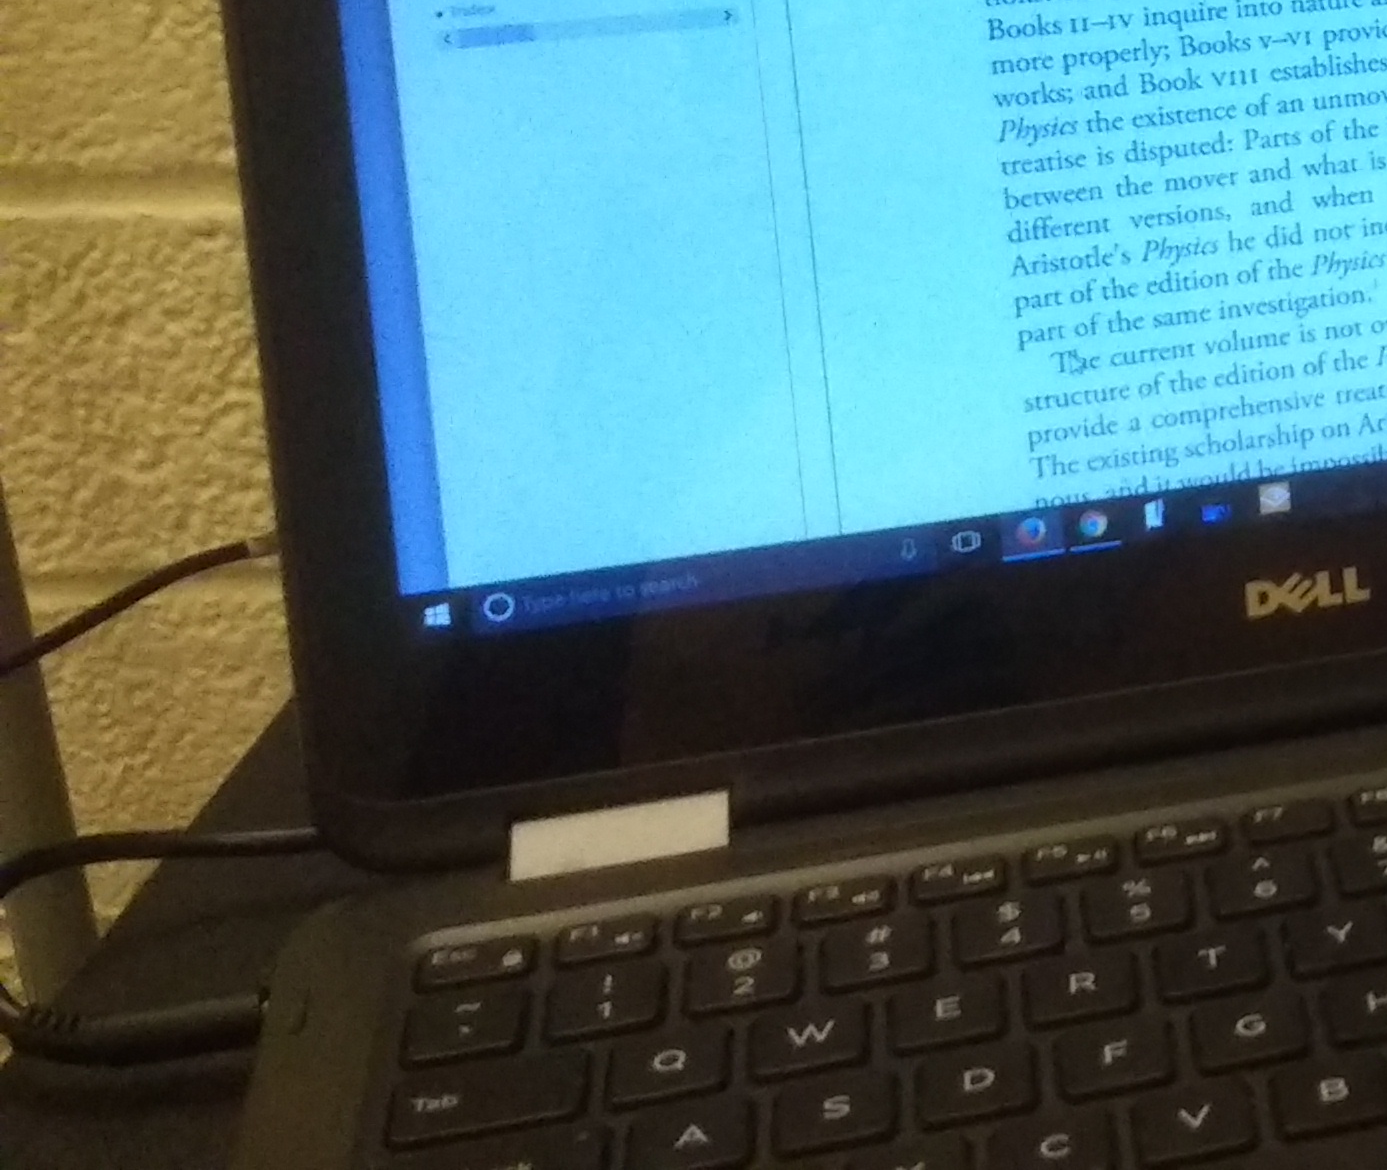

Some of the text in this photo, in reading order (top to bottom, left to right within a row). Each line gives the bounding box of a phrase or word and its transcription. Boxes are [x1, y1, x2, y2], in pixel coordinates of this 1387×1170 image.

[1030, 454, 1079, 480] The
[1087, 442, 1179, 472] existing
[1184, 422, 1314, 459] scholarship
[1322, 420, 1350, 439] on
[1245, 566, 1371, 618] DELL
[786, 945, 1226, 1046] W E R T
